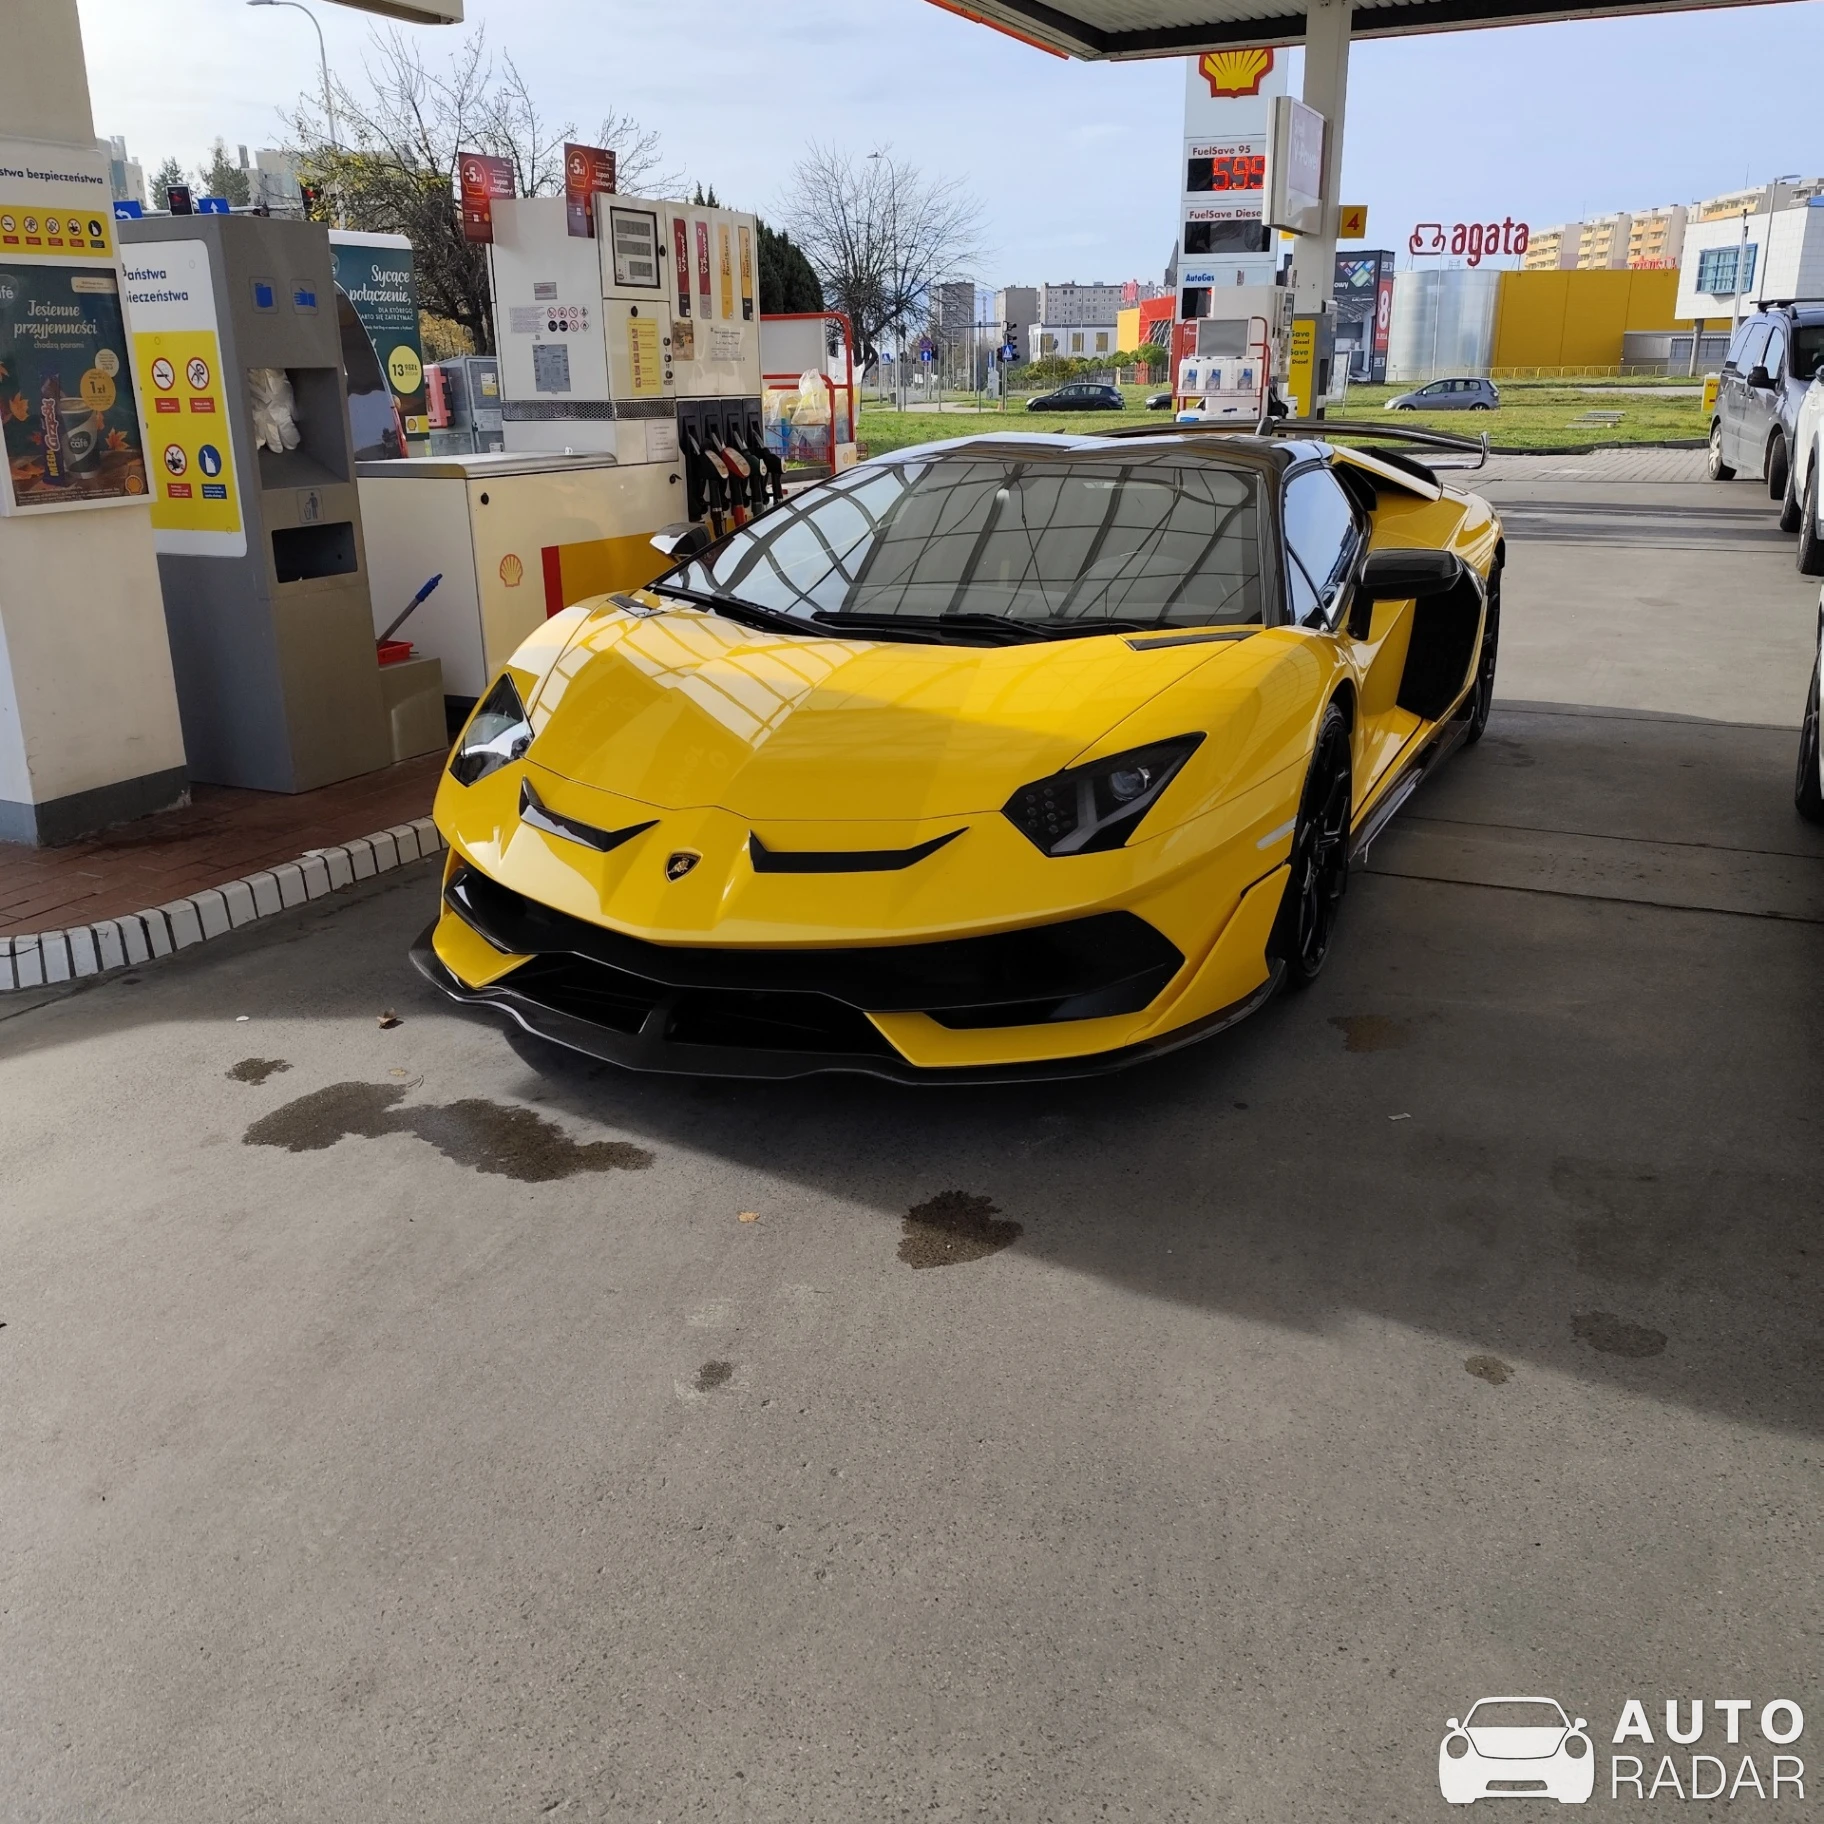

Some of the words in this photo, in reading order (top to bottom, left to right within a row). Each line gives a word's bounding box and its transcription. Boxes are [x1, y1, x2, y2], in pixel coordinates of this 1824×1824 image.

[1192, 146, 1235, 156] FuelSave
[1238, 145, 1251, 154] 95
[26, 168, 103, 184] bezpieczeństwa
[1213, 156, 1265, 191] 5.99
[1189, 209, 1232, 219] FuelSave
[1236, 208, 1263, 218] Diese
[1346, 213, 1360, 230] 4
[1451, 216, 1529, 267] agata
[371, 264, 410, 287] Sycące
[1185, 273, 1214, 282] AutoGas
[349, 282, 411, 305] połączenie,
[27, 299, 80, 317] Jesienne
[378, 306, 389, 314] DLA
[389, 305, 413, 314] KTÓREGO
[1379, 289, 1389, 331] 8
[375, 313, 384, 321] SIĘ
[385, 312, 414, 321] ZATRZYMAĆ
[13, 318, 97, 339] przyjemności
[33, 341, 60, 350] chodzą
[60, 342, 85, 350] parami
[392, 363, 404, 377] 13
[89, 381, 96, 394] 1
[97, 384, 106, 394] zł
